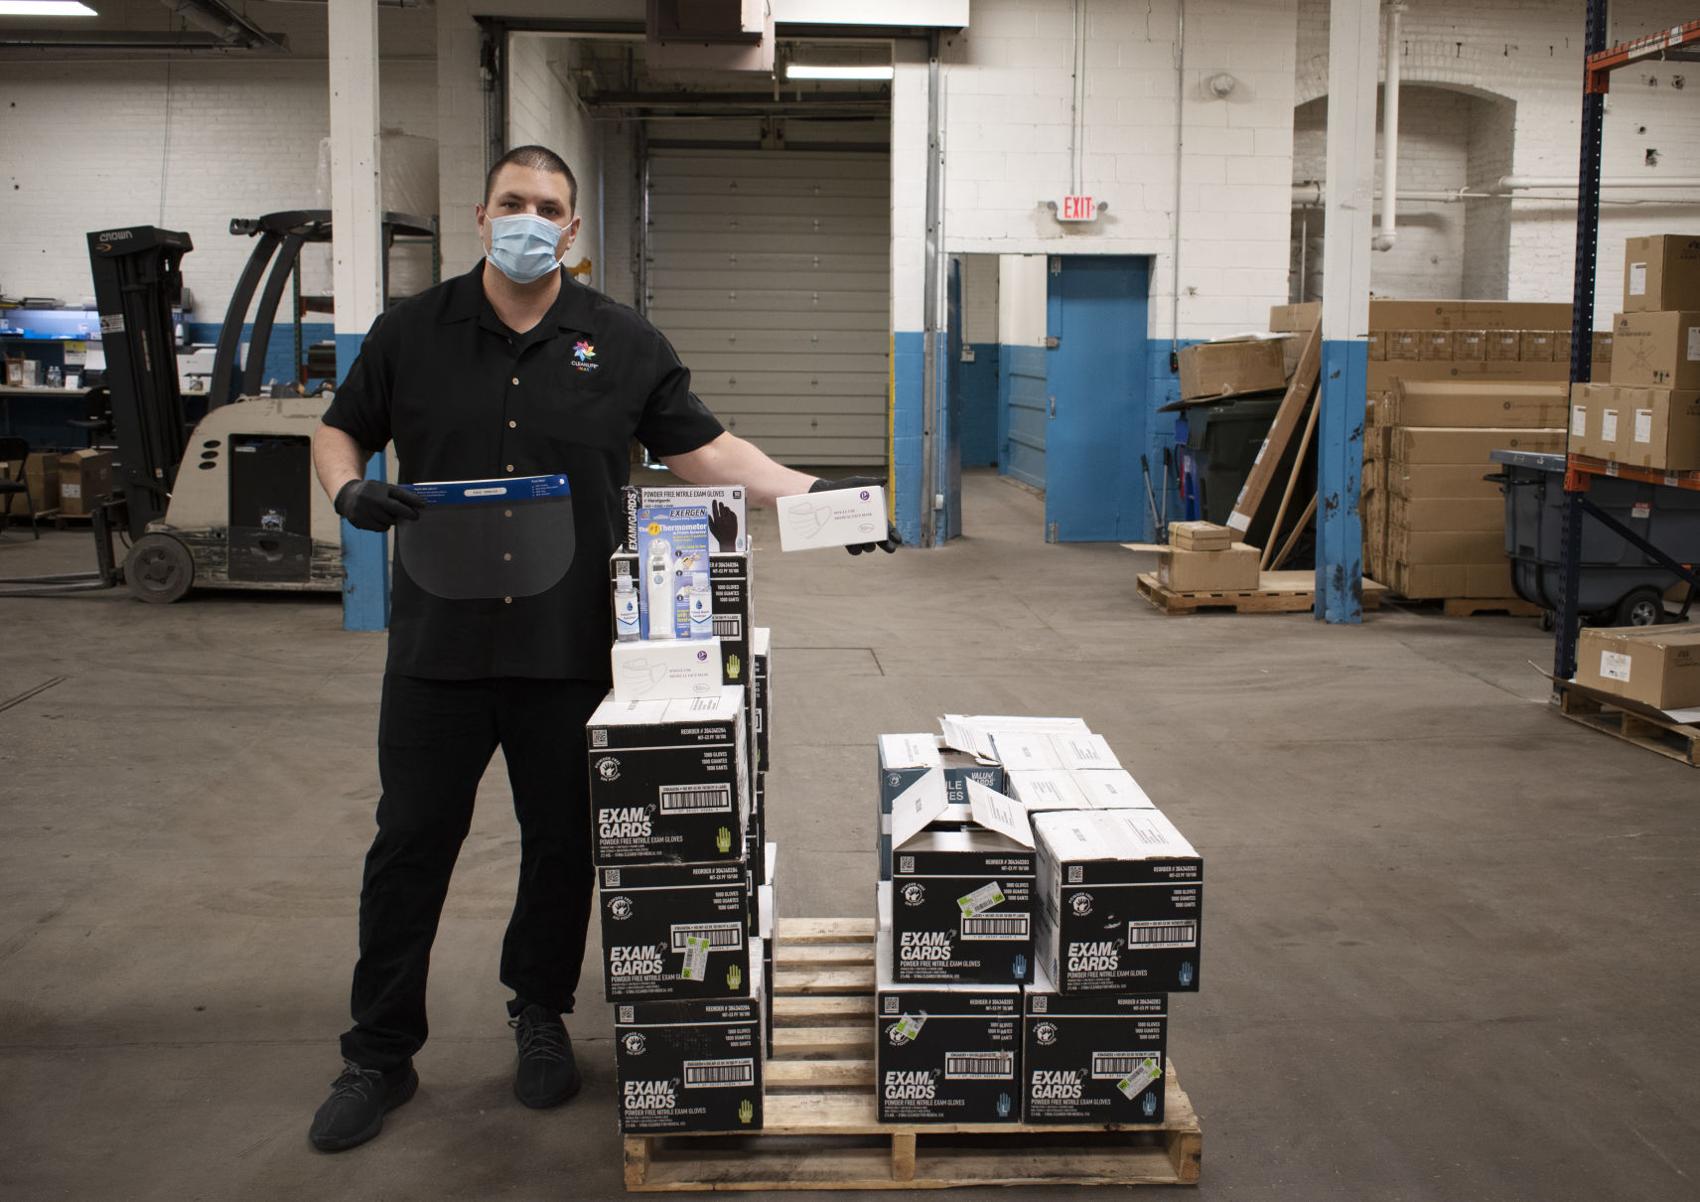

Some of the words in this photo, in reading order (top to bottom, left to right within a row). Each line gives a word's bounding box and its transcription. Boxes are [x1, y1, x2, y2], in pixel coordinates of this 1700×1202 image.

[1064, 196, 1092, 218] EXIT
[670, 509, 706, 518] EXERGEN
[659, 524, 706, 532] Thermometer
[598, 807, 645, 823] EXAM
[599, 822, 652, 839] GARDS
[665, 835, 684, 843] GLOVES
[900, 932, 945, 946] EXAM
[610, 945, 657, 961] EXAM
[900, 946, 951, 960] GARDS
[1068, 942, 1114, 957] EXAM
[611, 960, 663, 976] GARDS
[1068, 956, 1119, 971] GARDS
[1067, 971, 1087, 979] POWDER
[1130, 969, 1148, 977] GLOVES
[885, 1071, 930, 1085] EXAM
[1031, 1070, 1077, 1085] EXAM
[624, 1080, 670, 1096] EXAM
[885, 1085, 936, 1100] GARDS
[1031, 1084, 1082, 1099] GARDS
[624, 1094, 676, 1109] GARDS
[624, 1109, 645, 1117] POWDER
[657, 1108, 674, 1116] NITRILE
